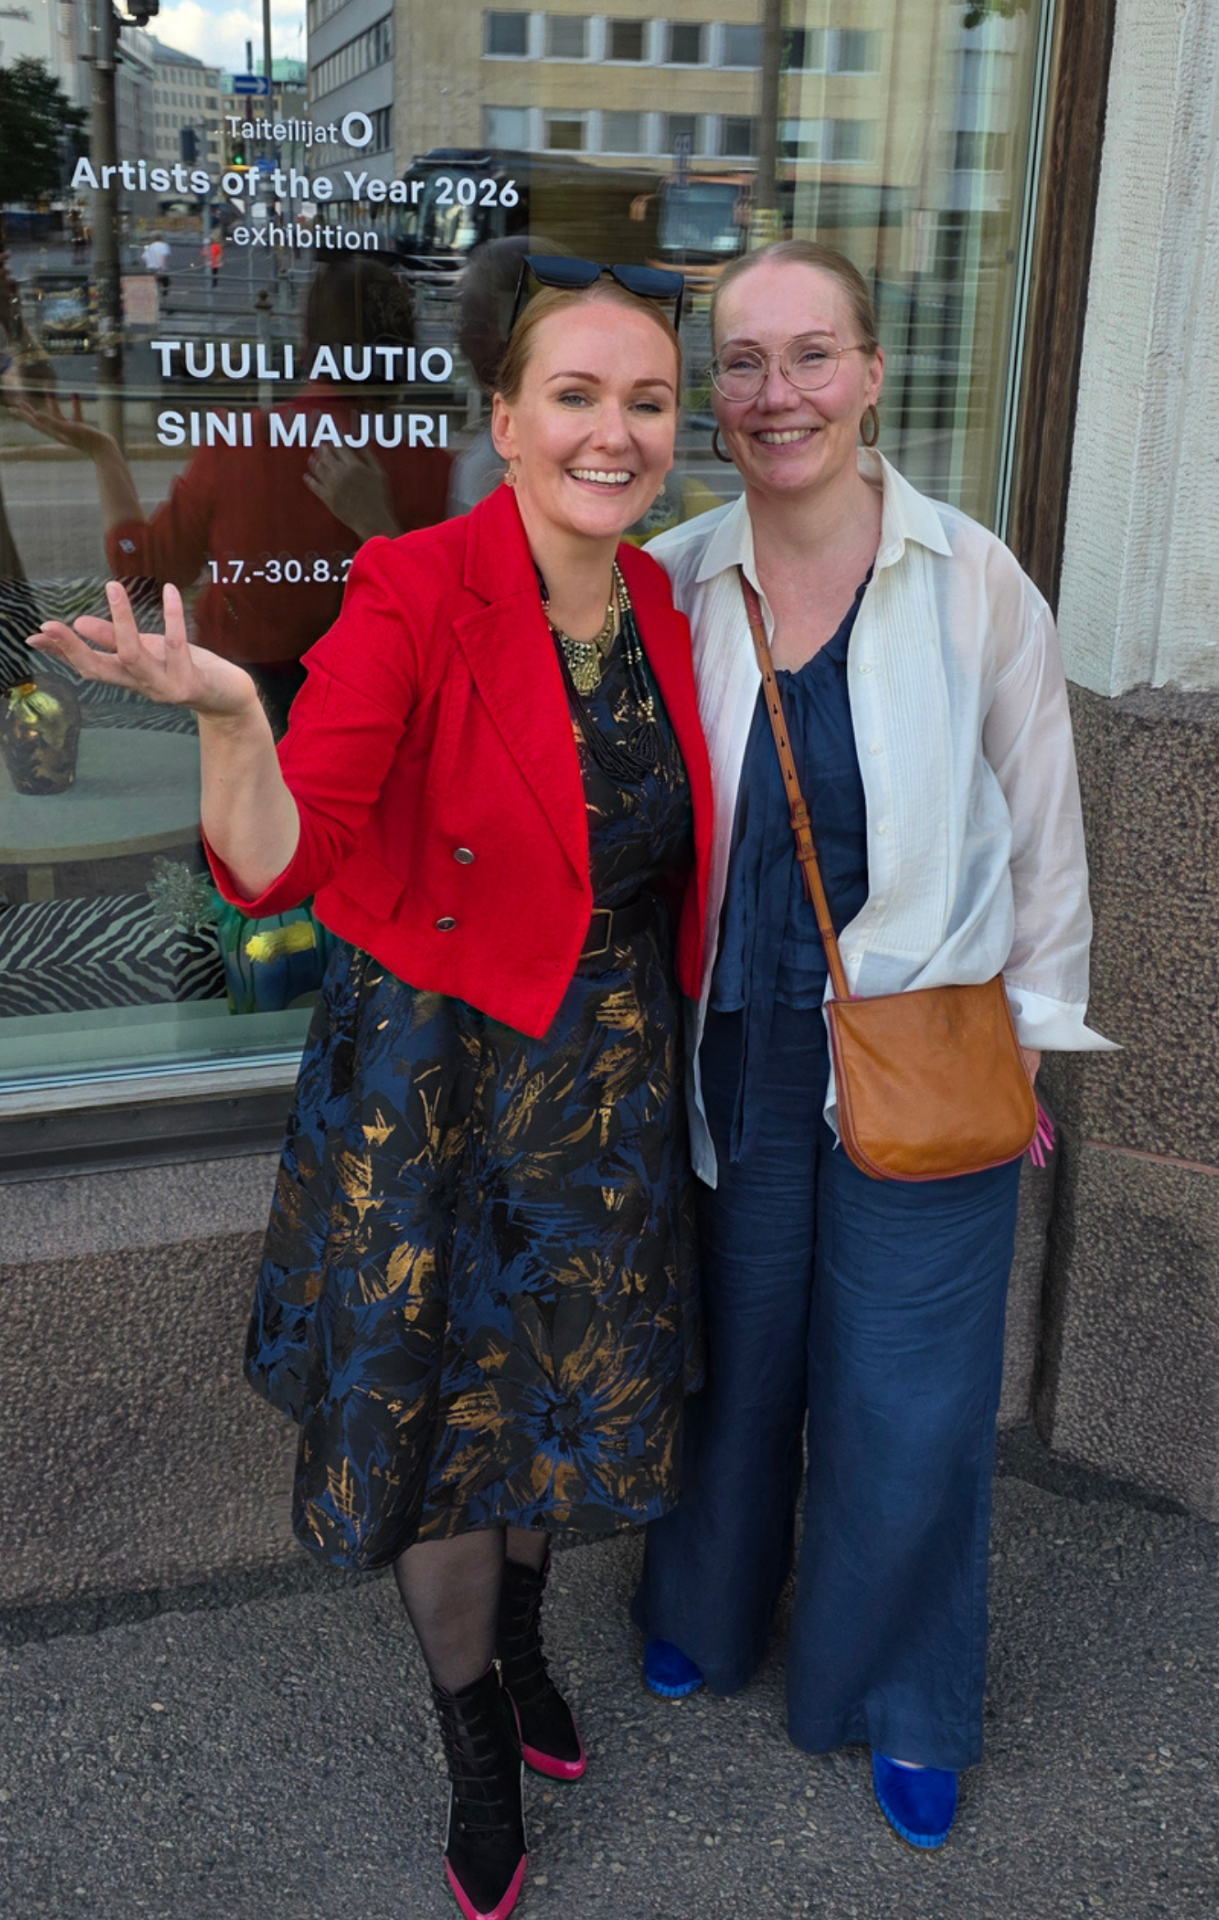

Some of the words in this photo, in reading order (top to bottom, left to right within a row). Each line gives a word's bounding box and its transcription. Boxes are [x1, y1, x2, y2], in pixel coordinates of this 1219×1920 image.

[225, 115, 338, 147] Taiteilijat
[71, 157, 210, 194] Artists
[222, 167, 260, 196] of
[270, 168, 333, 199] the
[344, 171, 424, 204] Year
[435, 177, 518, 208] 2026
[226, 222, 379, 251] -exhibition
[150, 341, 294, 379] TUULI
[310, 345, 454, 382] AUTIO
[157, 410, 252, 447] SINI
[269, 413, 448, 448] MAJURI
